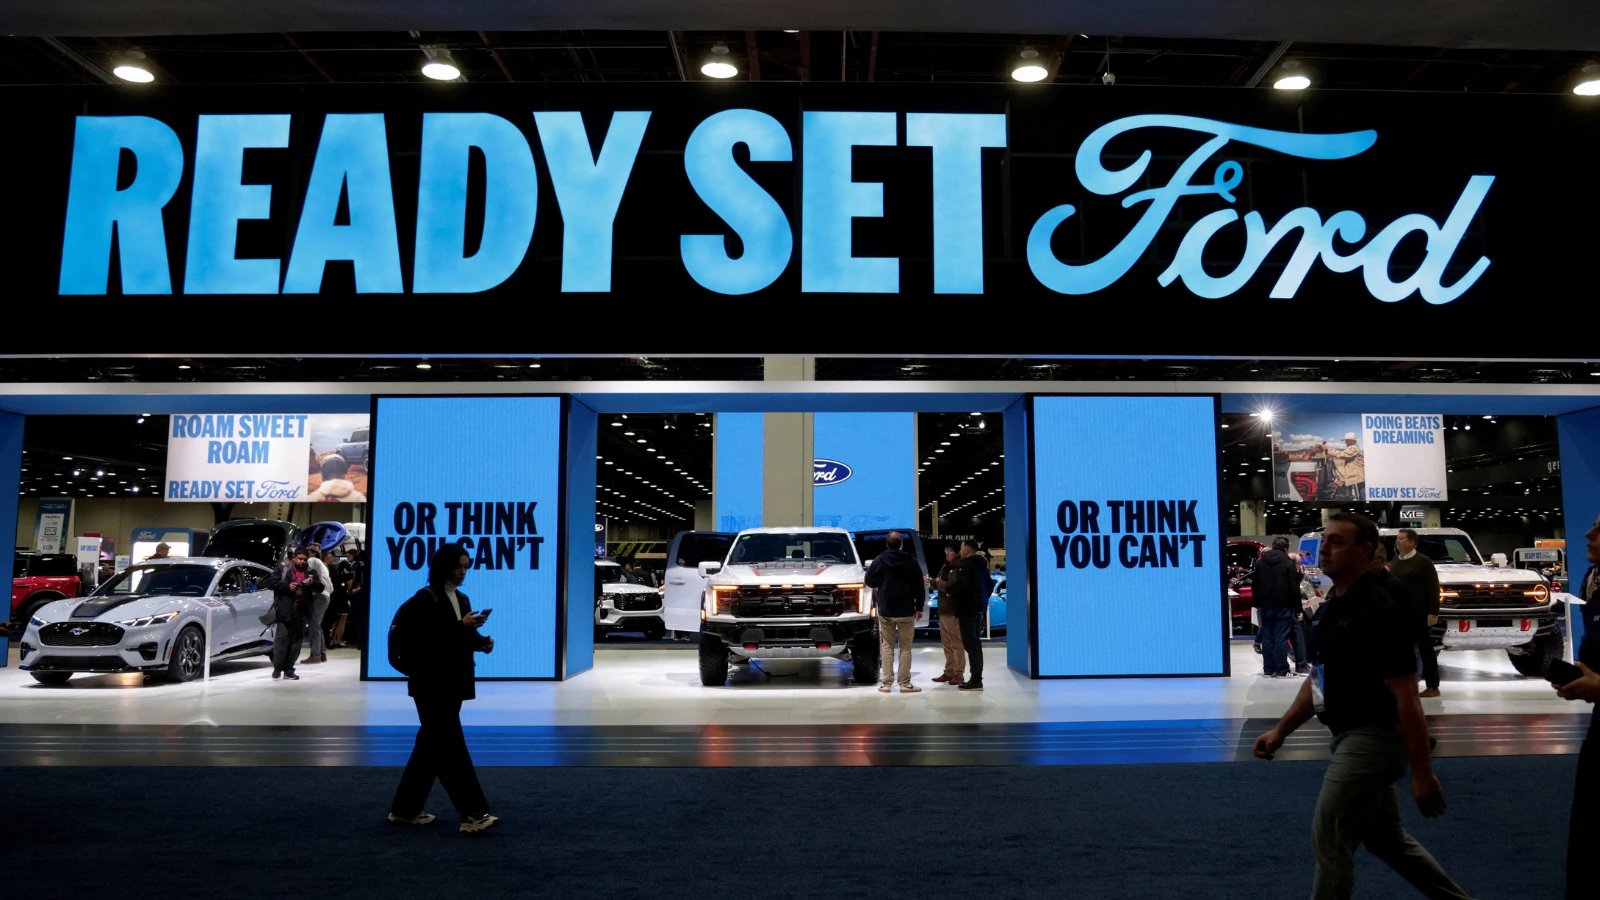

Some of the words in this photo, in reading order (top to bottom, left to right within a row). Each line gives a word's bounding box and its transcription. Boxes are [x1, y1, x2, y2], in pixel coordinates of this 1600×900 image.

[58, 110, 652, 296] READY
[680, 108, 1007, 296] SET
[1026, 114, 1496, 306] Ford
[172, 414, 234, 439] ROAM
[238, 414, 309, 439] SWEET
[1366, 416, 1402, 429] DOING
[1405, 416, 1440, 429] BEATS
[1373, 431, 1434, 444] DREAMING
[207, 440, 270, 465] ROAM
[814, 464, 838, 481] rd
[168, 480, 222, 499] READY
[224, 480, 254, 499] SET
[256, 480, 301, 500] Ford
[1369, 488, 1398, 498] READY
[1400, 488, 1416, 498] SET
[1418, 487, 1441, 498] Ford
[393, 501, 438, 536] OR
[444, 501, 539, 536] THINK
[1056, 499, 1100, 534] OR
[1106, 499, 1199, 534] THINK
[1050, 534, 1112, 569] YOU
[1118, 534, 1207, 569] CAN'T
